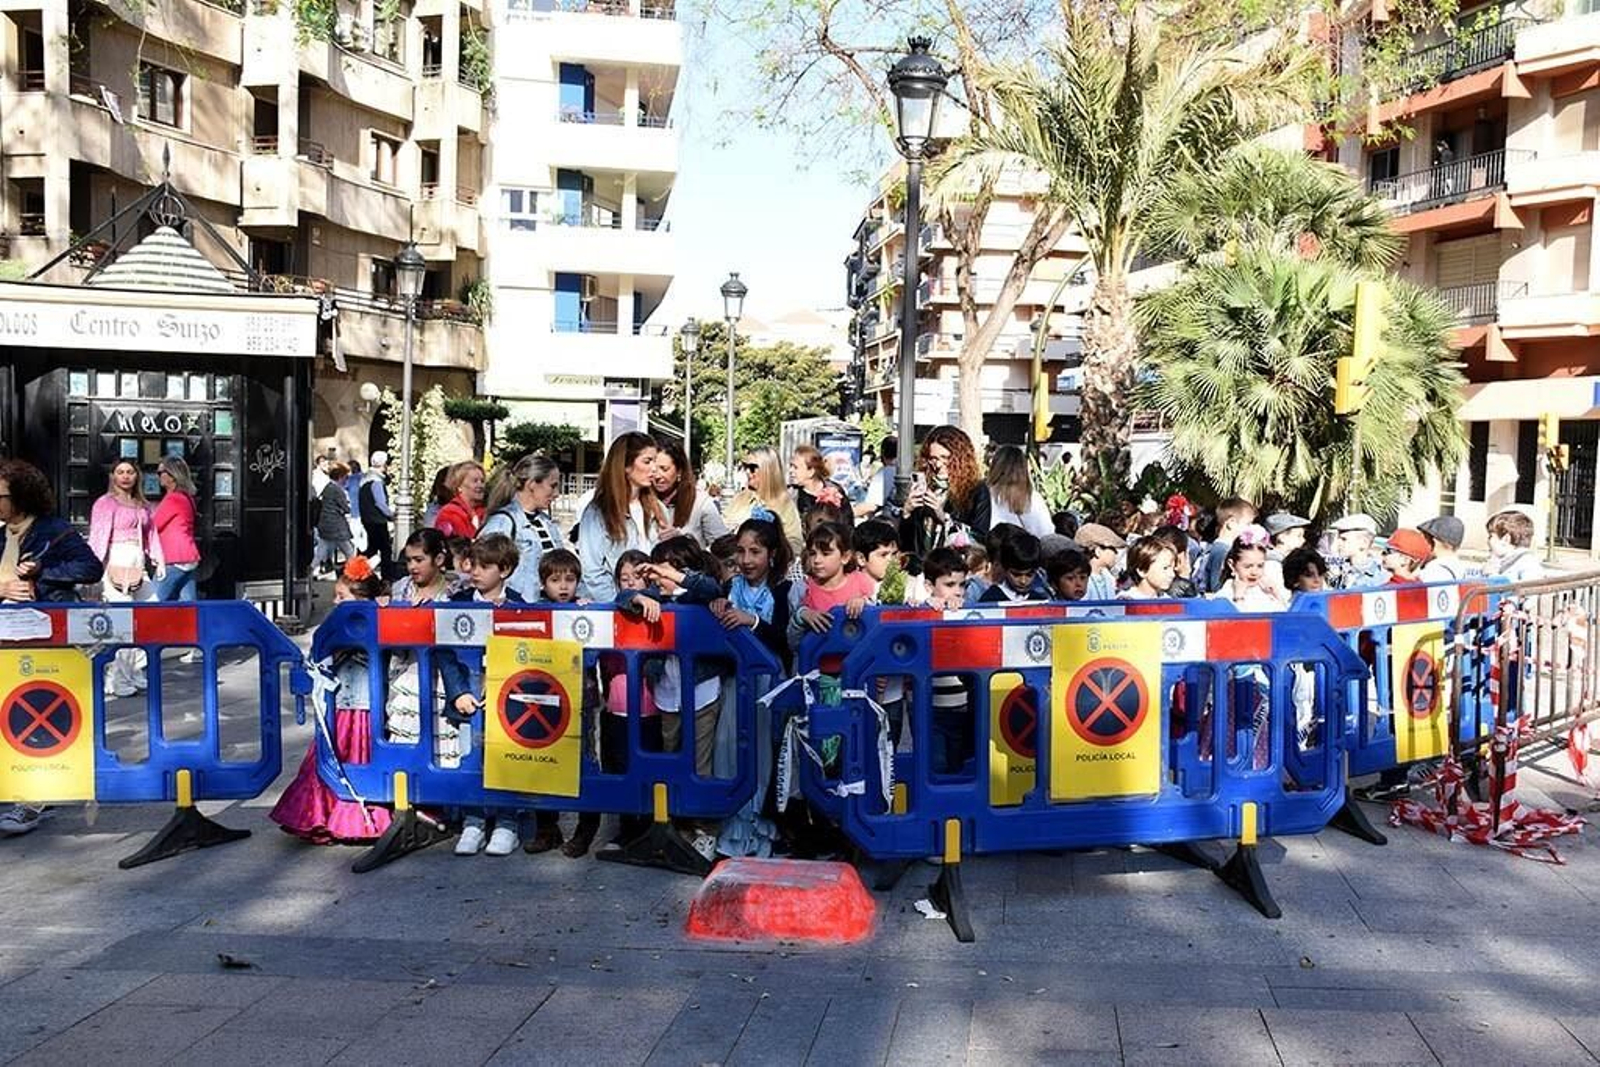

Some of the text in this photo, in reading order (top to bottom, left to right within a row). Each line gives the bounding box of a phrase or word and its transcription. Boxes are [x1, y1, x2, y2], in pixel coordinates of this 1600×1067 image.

[70, 310, 220, 345] Centro Suizo
[535, 755, 558, 764] LOCAL
[1110, 752, 1135, 761] LOCAL
